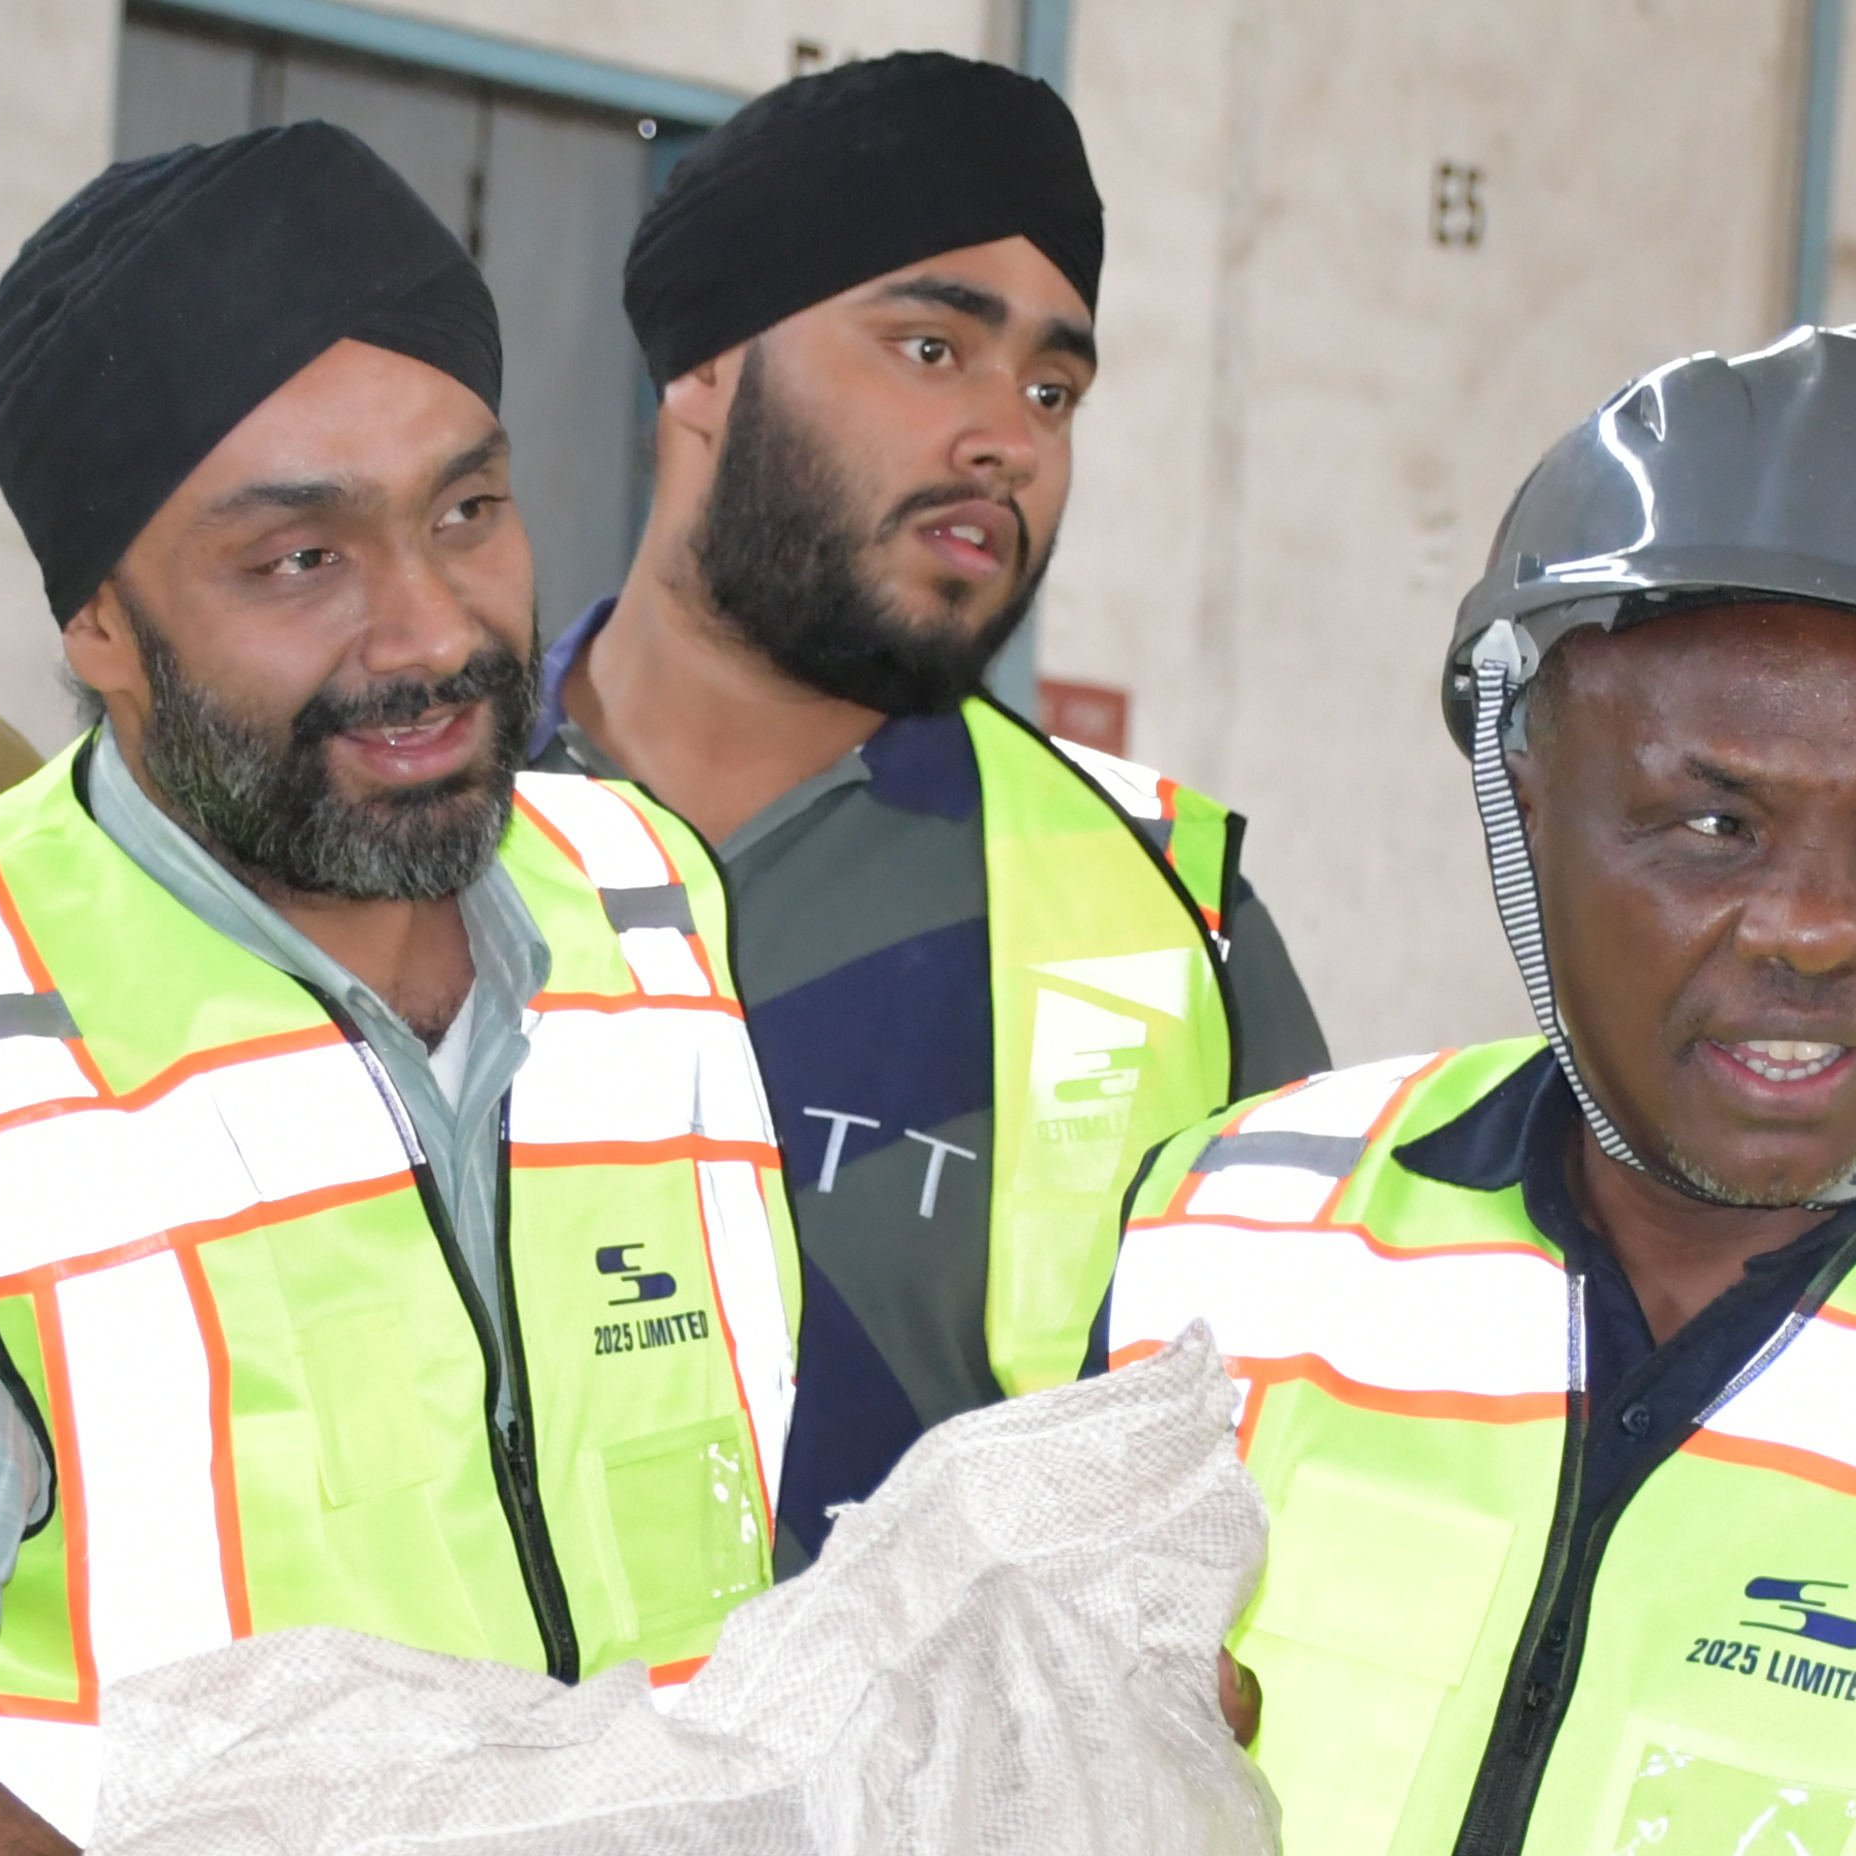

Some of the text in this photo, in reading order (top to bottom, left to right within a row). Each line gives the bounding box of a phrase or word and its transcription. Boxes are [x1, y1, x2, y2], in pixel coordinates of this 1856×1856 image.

[594, 1309, 710, 1356] 2025 LIMITED
[1685, 1637, 1761, 1676] 2025
